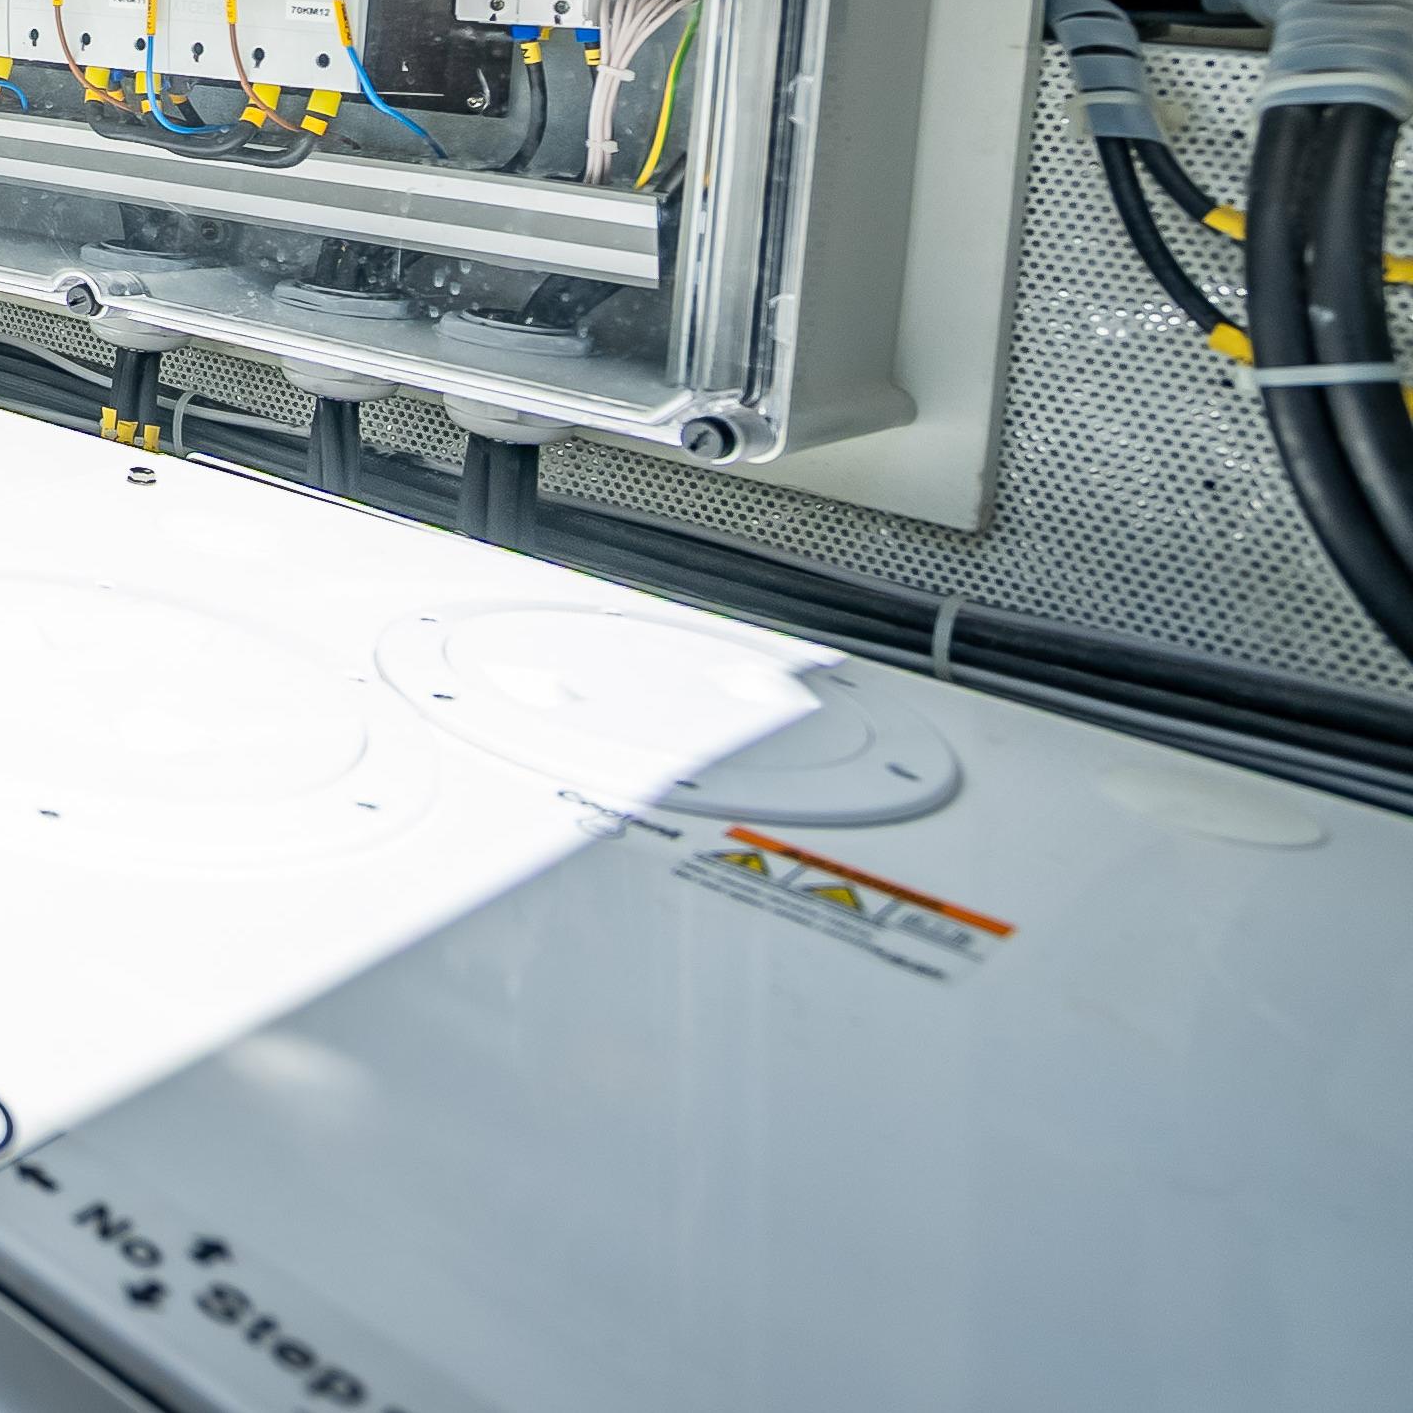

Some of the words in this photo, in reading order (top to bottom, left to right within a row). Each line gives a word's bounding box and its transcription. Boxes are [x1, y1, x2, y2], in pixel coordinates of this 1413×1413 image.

[291, 5, 331, 16] 70KM12
[73, 1200, 163, 1270] No
[194, 1281, 368, 1409] Step
